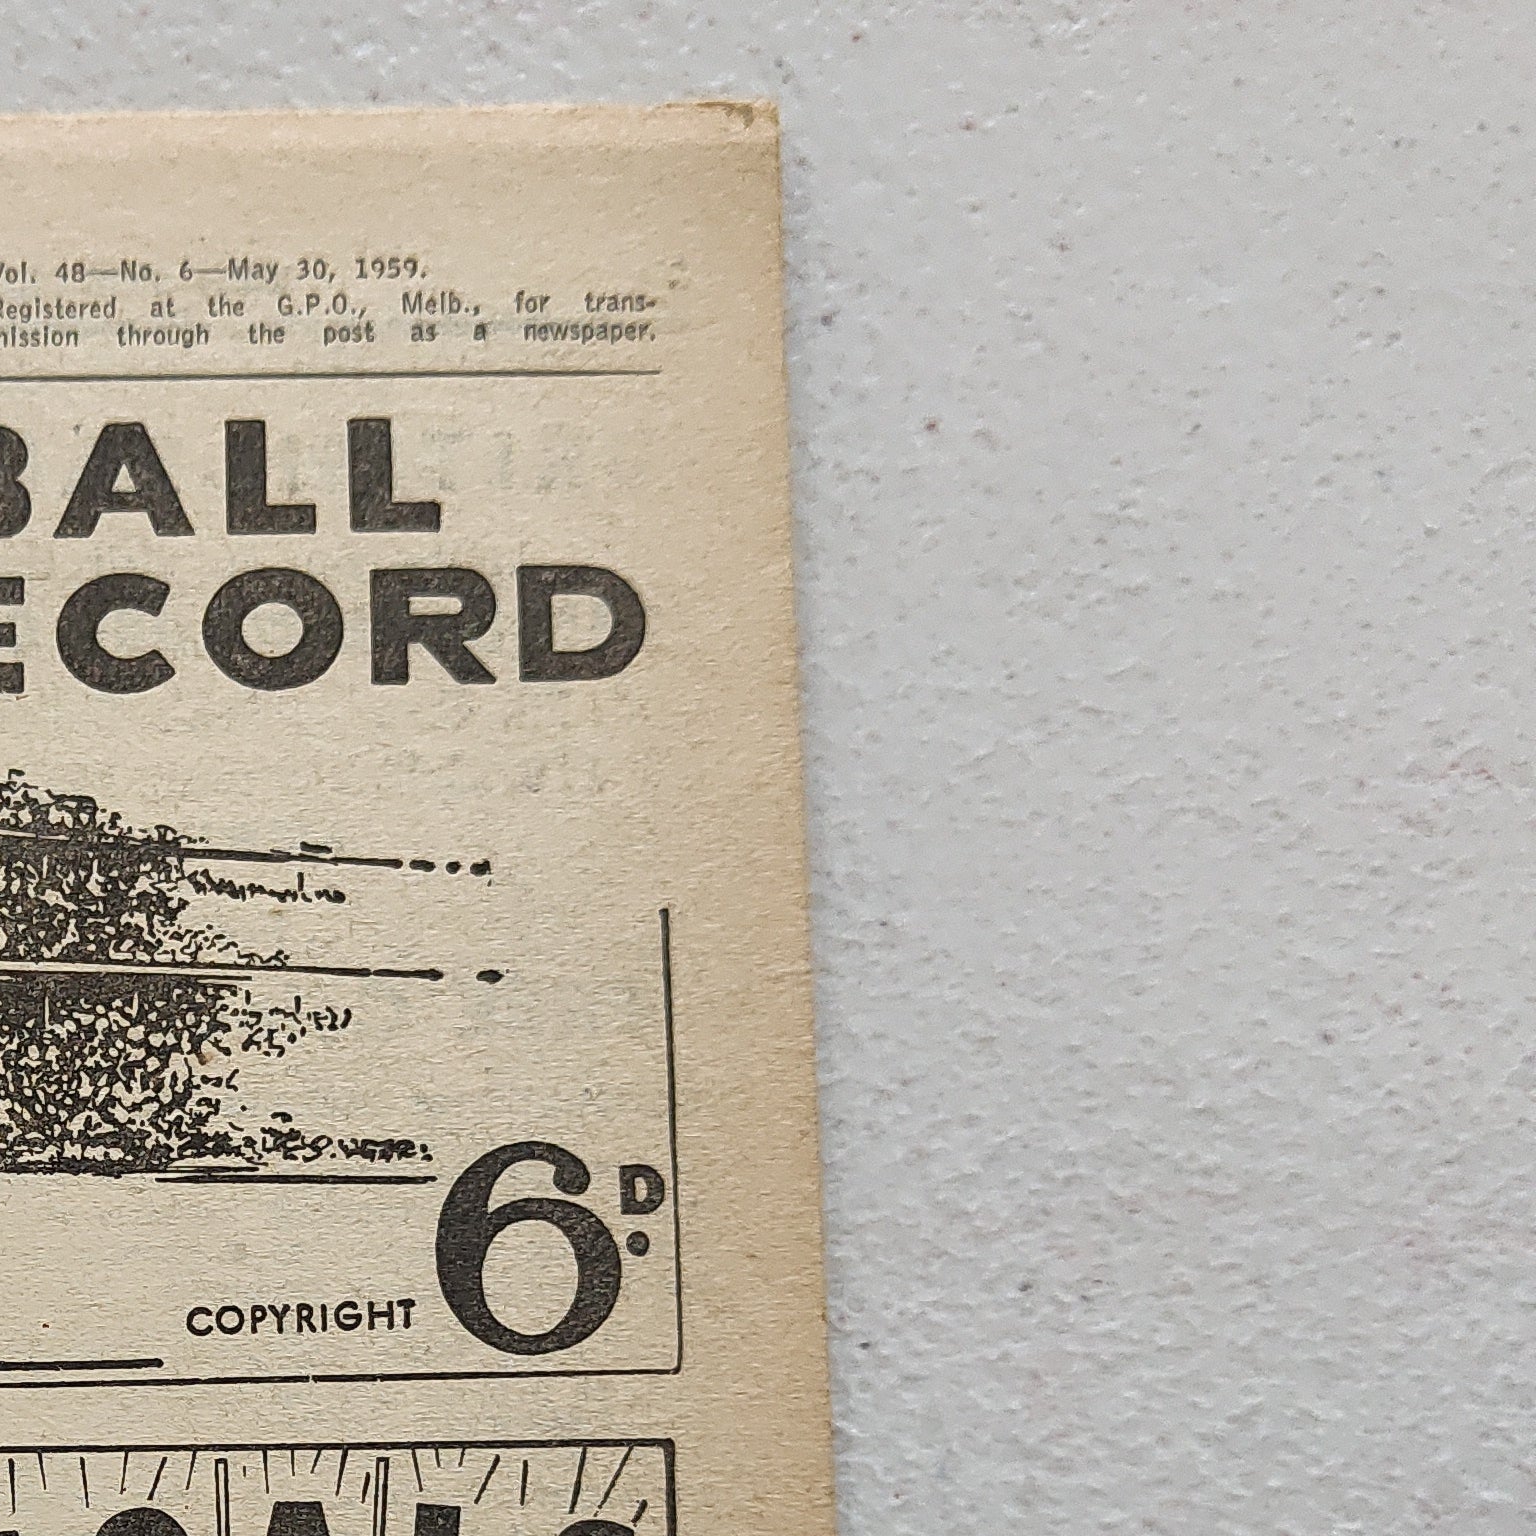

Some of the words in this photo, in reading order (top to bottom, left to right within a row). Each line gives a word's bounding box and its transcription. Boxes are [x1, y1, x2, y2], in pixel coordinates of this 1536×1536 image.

[296, 258, 336, 284] 30,
[355, 258, 428, 281] 1959.
[150, 296, 175, 318] at
[207, 295, 245, 317] the
[276, 293, 367, 318] G.P.O.,
[402, 292, 482, 317] Melb.,
[514, 291, 550, 314] for
[584, 293, 656, 314] trans-
[117, 323, 210, 349] through
[248, 322, 285, 345] the
[323, 321, 375, 348] post
[410, 324, 436, 343] as
[473, 323, 487, 342] a
[523, 321, 656, 347] newspaper.
[186, 1300, 416, 1336] COPYRIGHT
